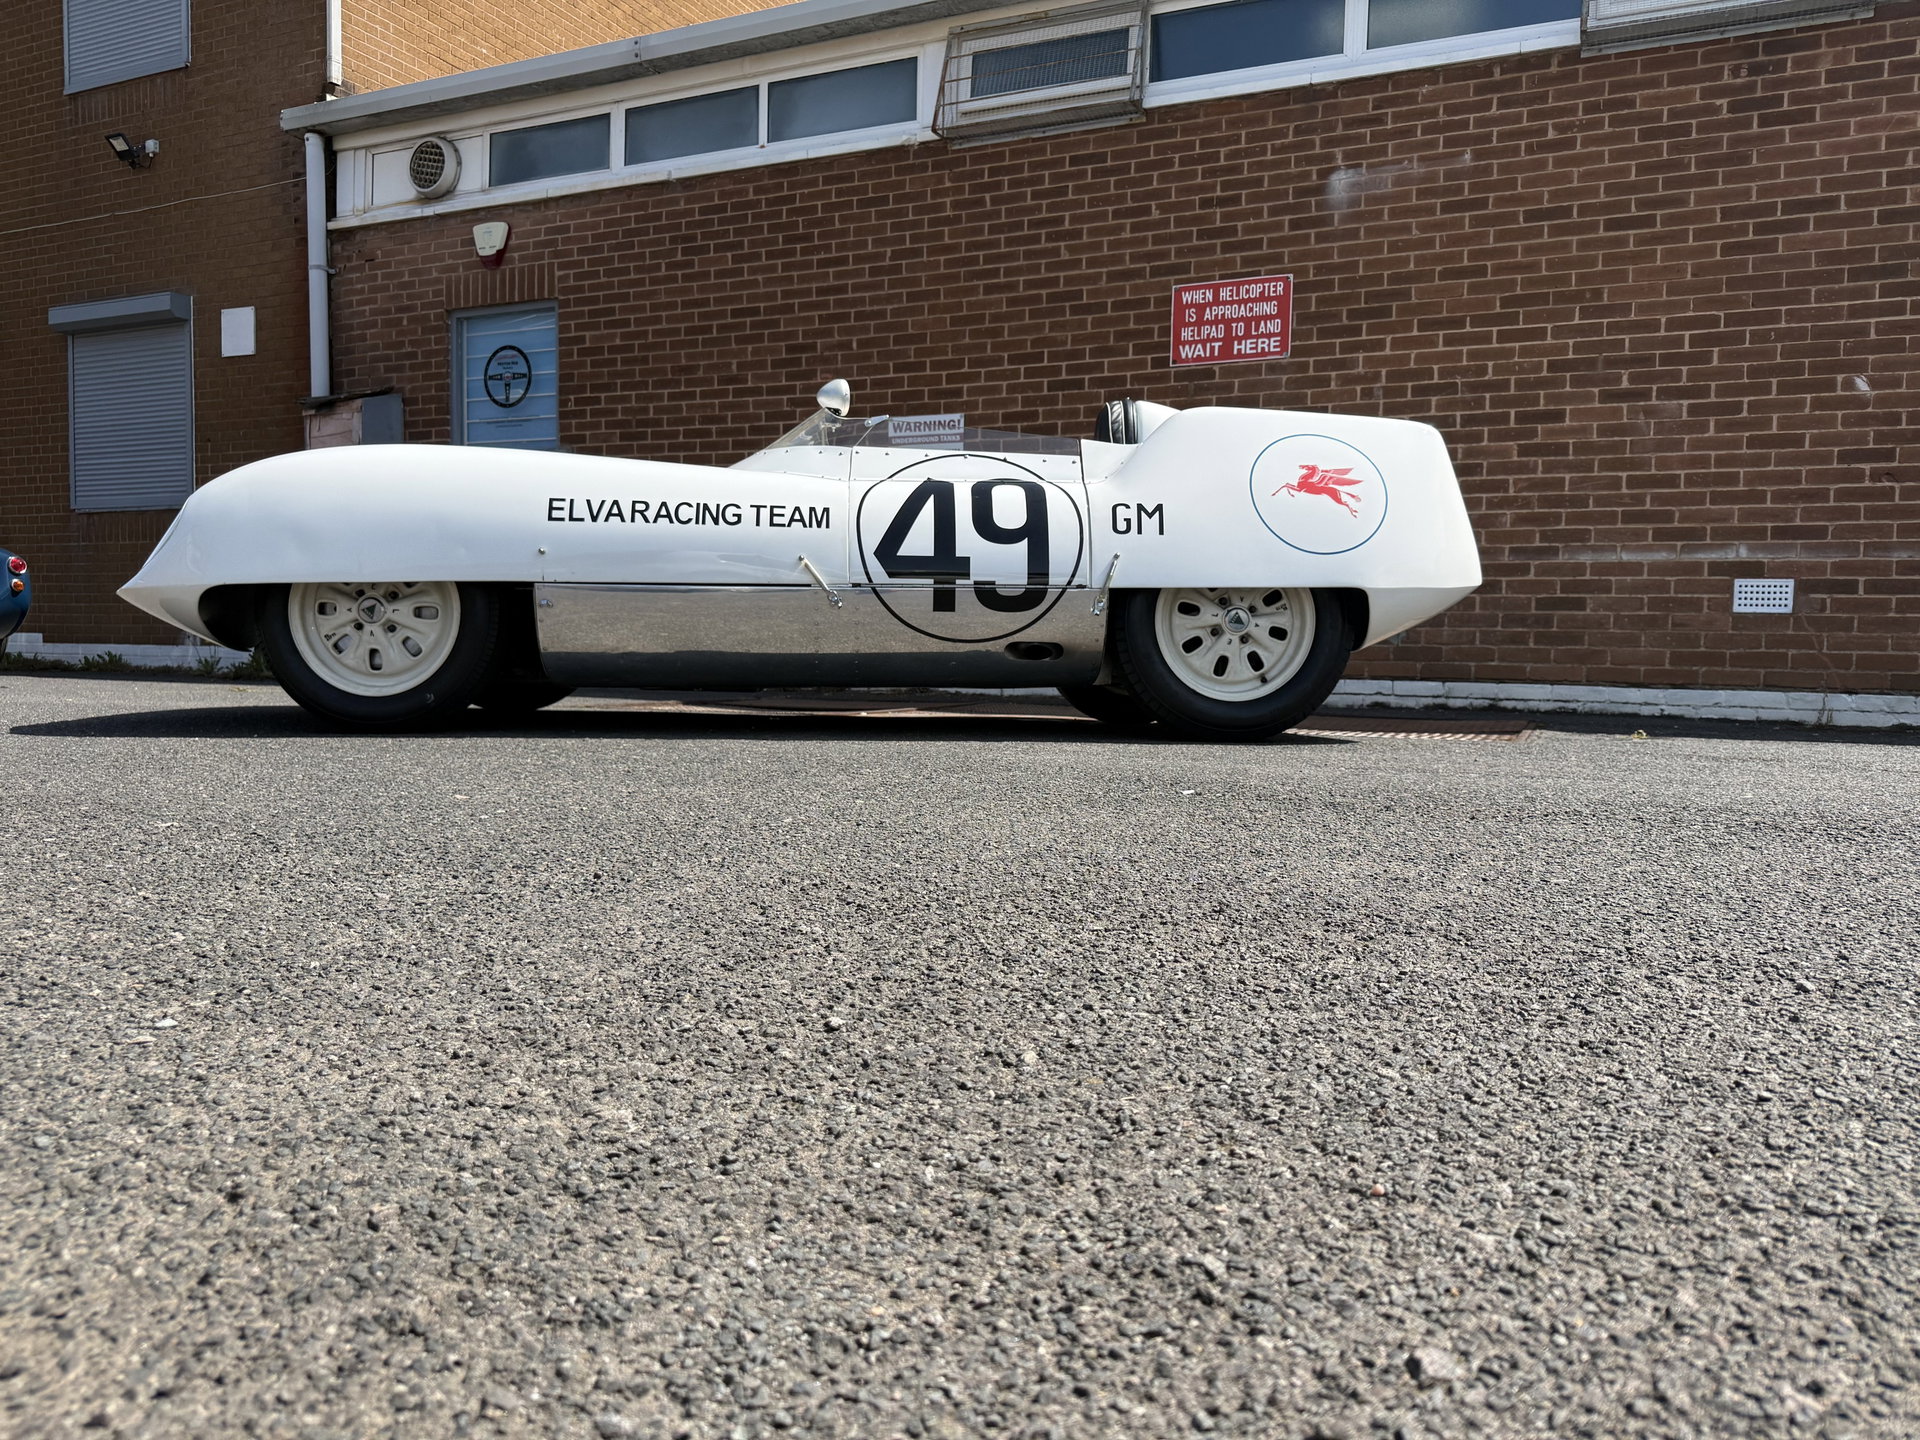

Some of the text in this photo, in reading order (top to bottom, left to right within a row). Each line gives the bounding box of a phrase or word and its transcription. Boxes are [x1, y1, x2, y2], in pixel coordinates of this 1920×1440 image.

[1182, 282, 1284, 305] WHEN HELICOPTER
[1185, 301, 1278, 322] IS APPROACHING
[1181, 319, 1281, 341] HELIPAD TO LAND
[1179, 337, 1281, 359] WAIT HERE
[892, 419, 961, 433] WARNING!
[750, 504, 830, 529] TEAM
[1111, 503, 1165, 536] GM
[873, 477, 1050, 612] 49
